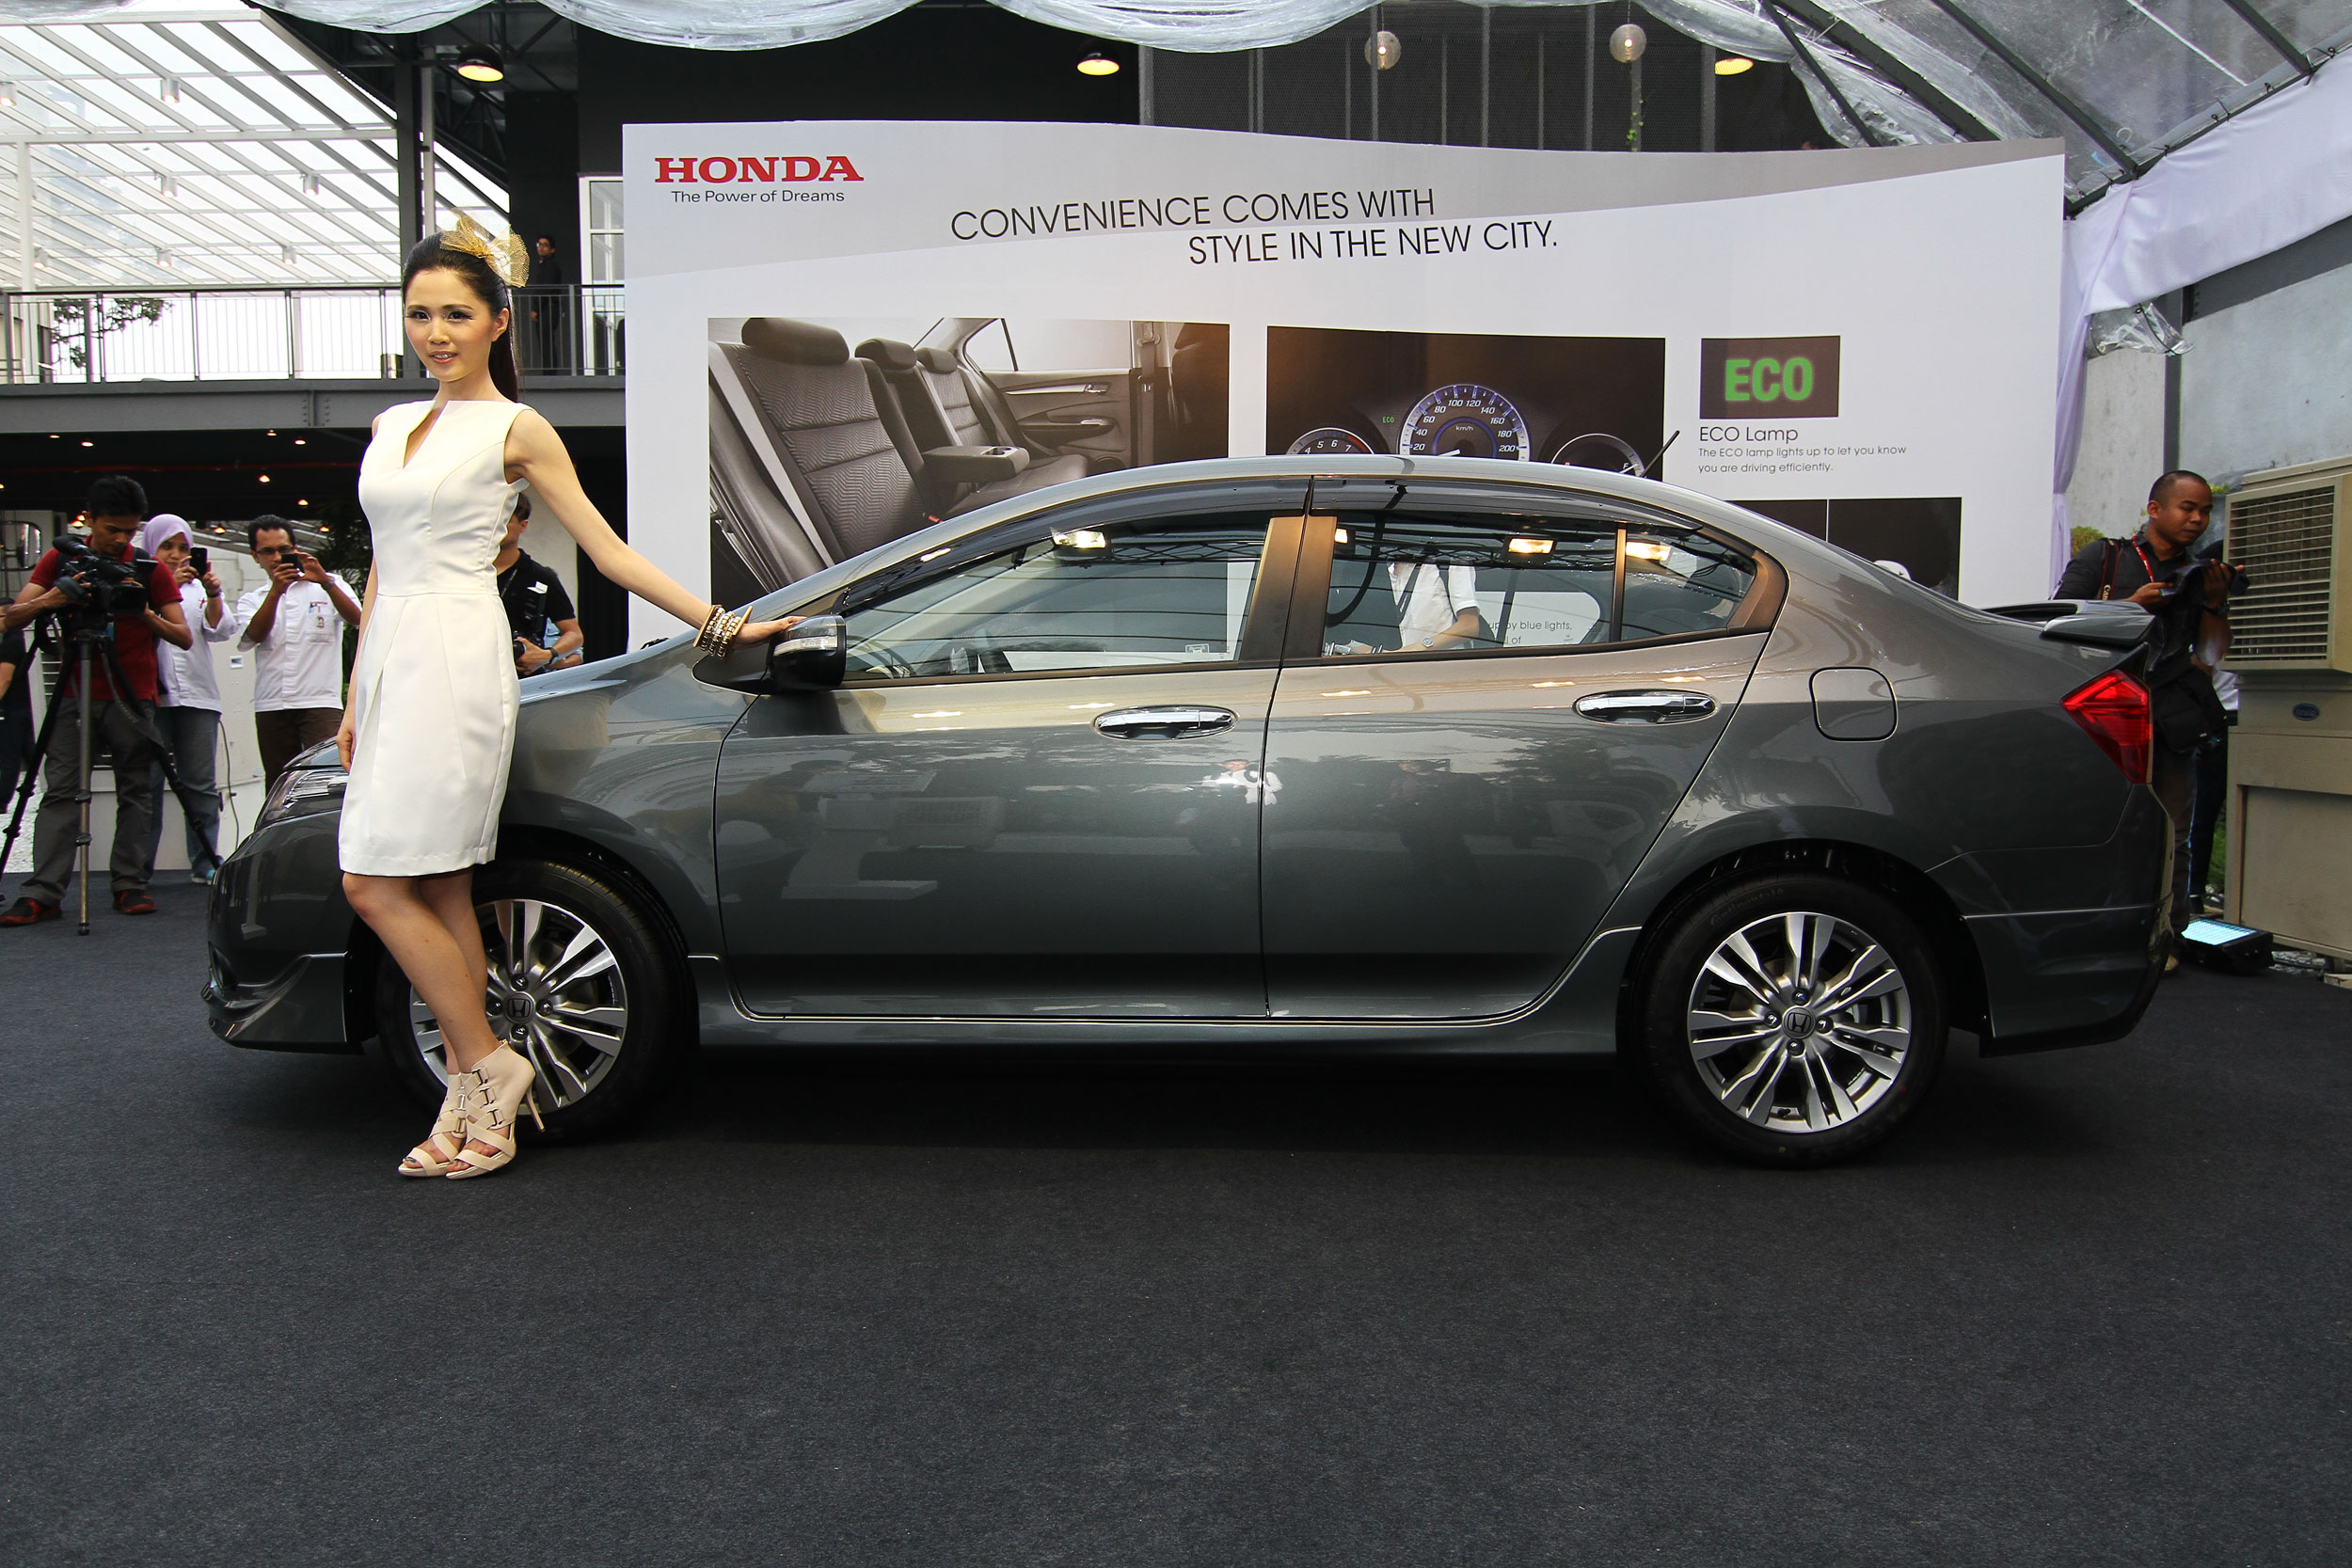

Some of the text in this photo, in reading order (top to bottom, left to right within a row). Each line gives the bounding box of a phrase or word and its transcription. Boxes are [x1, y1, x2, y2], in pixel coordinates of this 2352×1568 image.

[655, 155, 865, 183] HONDA
[671, 189, 845, 203] The Power of Dreams
[951, 188, 1434, 241] CONVENIENCE COMES WITH
[1189, 219, 1558, 264] STYLE IN THE NEW CITY.
[1724, 356, 1814, 402] ECO
[1448, 399, 1464, 407] 100
[1466, 399, 1482, 407] 120
[1434, 405, 1447, 414] 80
[1480, 406, 1496, 415] 140
[1416, 428, 1428, 436] 40
[1498, 430, 1513, 438] 180
[1699, 426, 1799, 444] ECO Lamp
[1316, 440, 1325, 449] 5
[1331, 439, 1339, 448] 6
[1345, 444, 1352, 452] 7
[1412, 443, 1425, 451] 20
[1699, 445, 1907, 458] The ECO lamp lights up to let you know
[1698, 462, 1835, 474] you are driving efficiently.
[1519, 621, 1542, 630] blue
[1544, 621, 1573, 631] lights,
[1511, 636, 1522, 644] of
